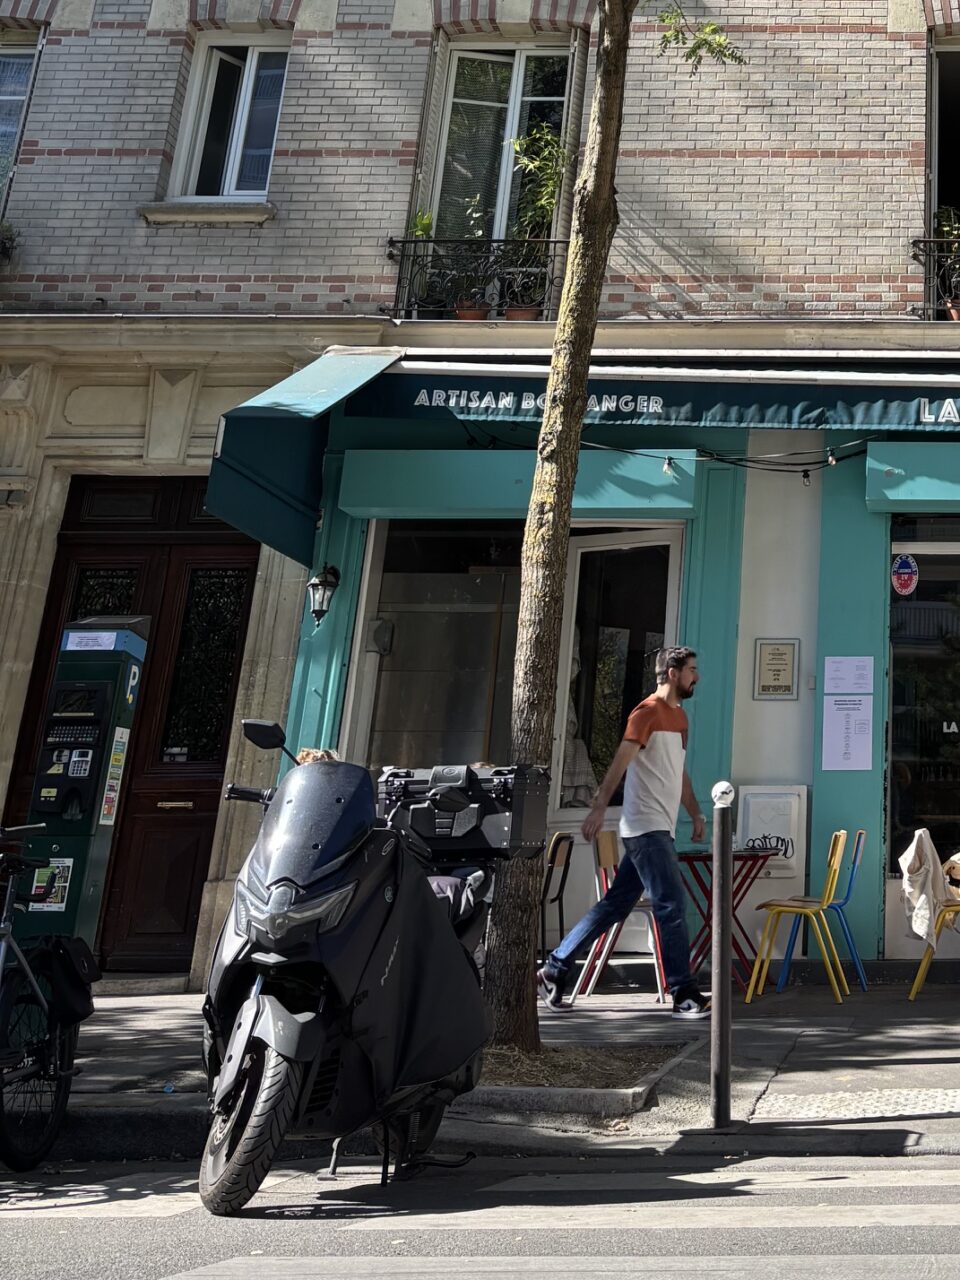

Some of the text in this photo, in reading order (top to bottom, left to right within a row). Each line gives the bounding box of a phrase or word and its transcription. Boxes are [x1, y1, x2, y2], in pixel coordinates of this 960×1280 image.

[414, 389, 664, 413] ARTISAN BOANGER
[919, 398, 960, 423] LA
[942, 721, 959, 733] LA
